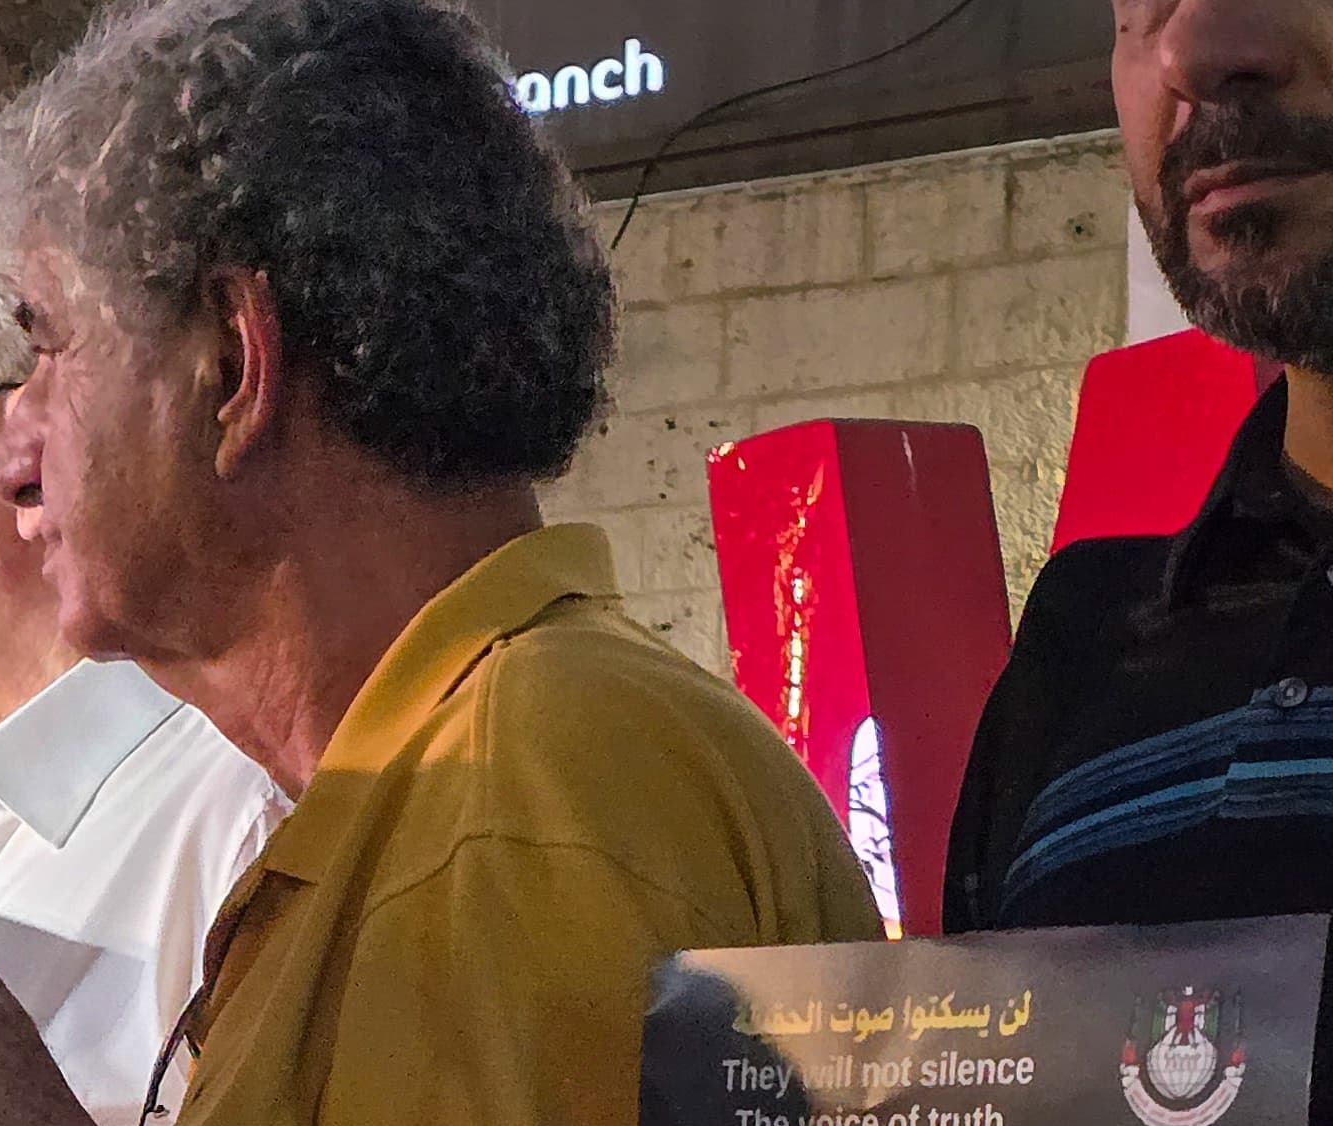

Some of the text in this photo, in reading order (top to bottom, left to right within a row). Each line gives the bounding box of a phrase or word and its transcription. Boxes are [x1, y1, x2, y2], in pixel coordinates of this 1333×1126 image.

[516, 38, 663, 113] anch
[831, 1003, 895, 1042] صوت
[903, 991, 991, 1041] يسكتوا
[999, 990, 1031, 1036] لن
[723, 1051, 1034, 1098] They will not silence
